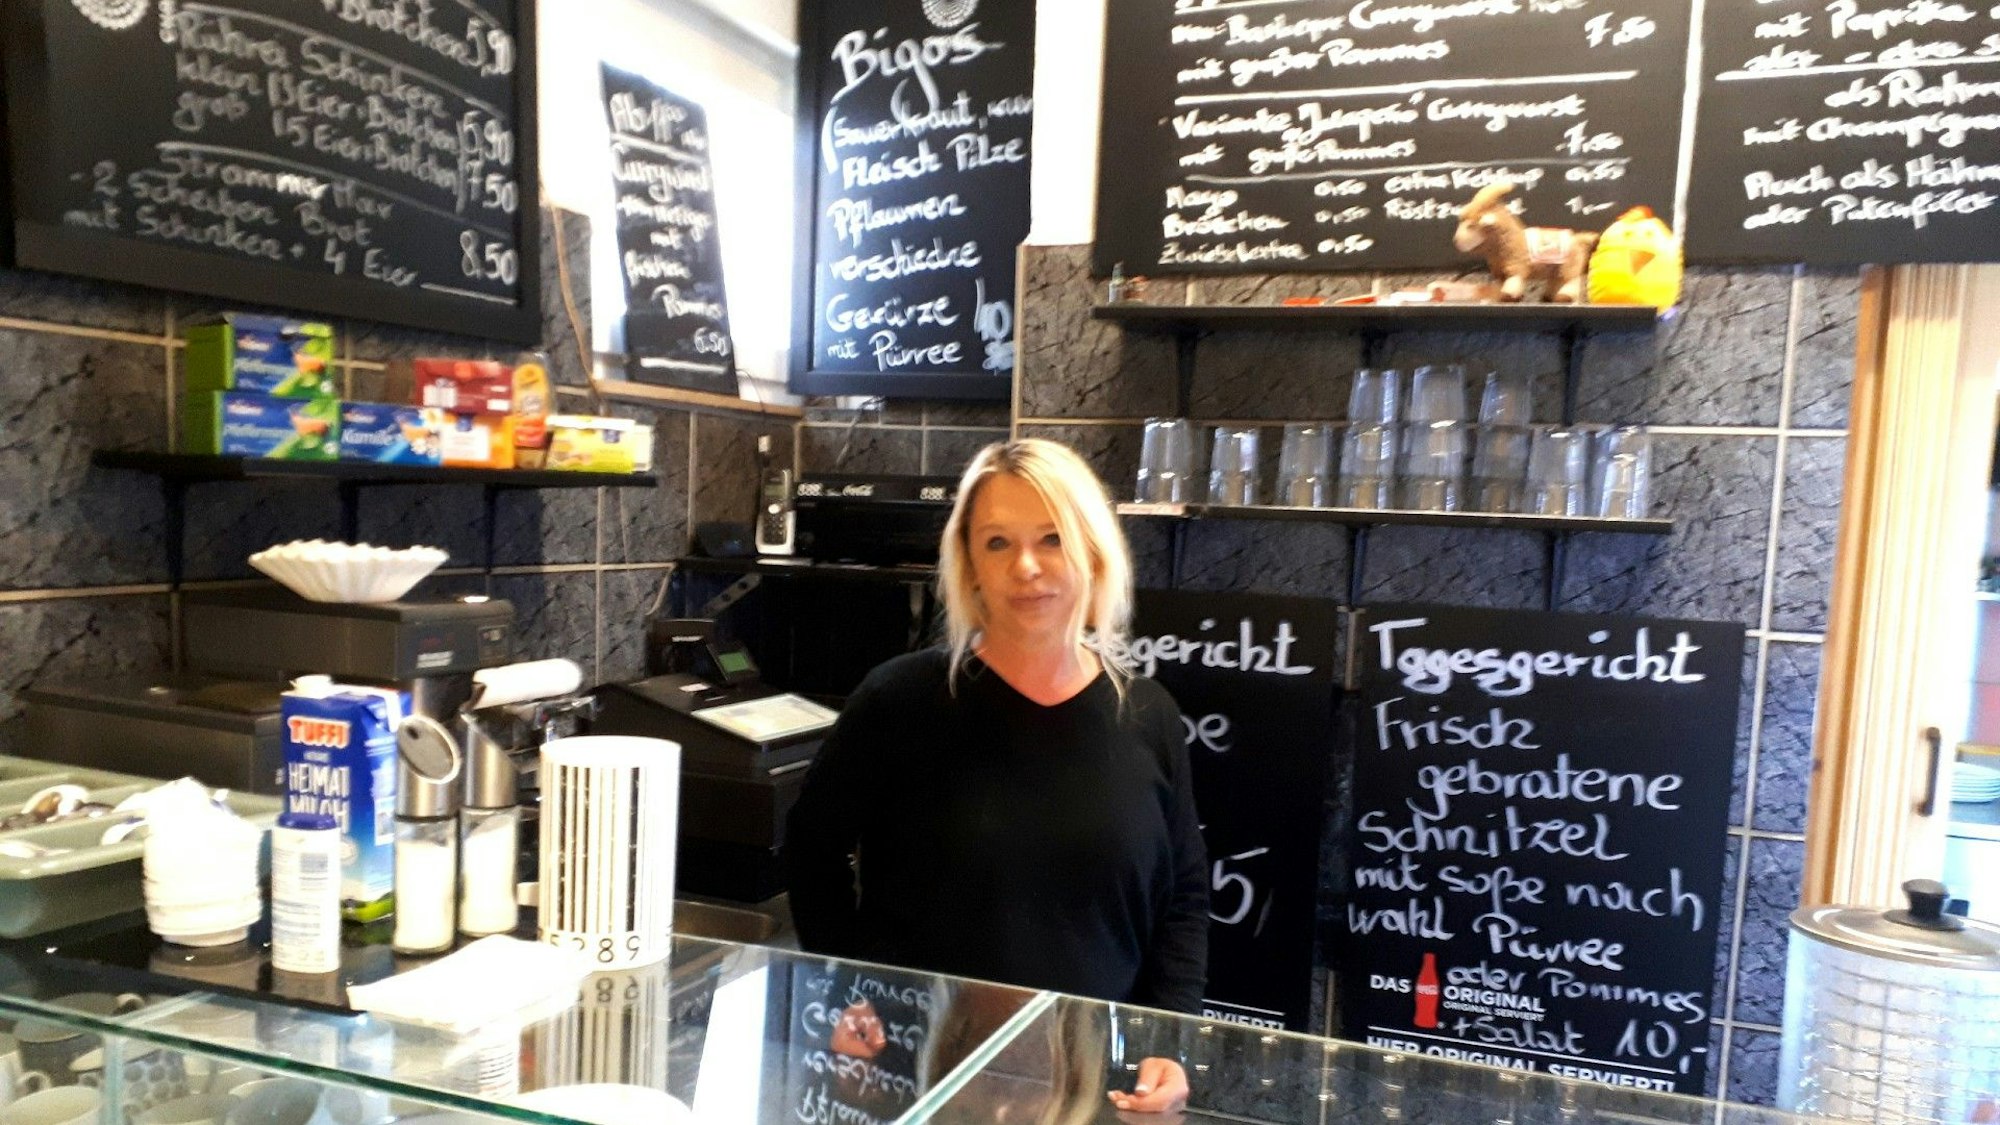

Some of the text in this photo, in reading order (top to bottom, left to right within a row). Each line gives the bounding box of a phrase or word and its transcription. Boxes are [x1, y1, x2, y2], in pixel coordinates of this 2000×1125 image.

[830, 22, 1005, 125] Bigos
[842, 140, 943, 191] Fleisch
[1743, 164, 1836, 200] Auch
[1840, 158, 1901, 190] als
[827, 192, 968, 248] Pflaumen
[1372, 697, 1541, 751] Frisch
[288, 762, 350, 798] HEIMAT
[1406, 753, 1684, 821] gebratene
[1358, 806, 1630, 863] Schnitzel
[1355, 853, 1428, 891] mit
[1565, 867, 1705, 932] nach
[1472, 912, 1625, 971] Pürree
[1370, 974, 1412, 995] DAS
[1443, 985, 1547, 1013] ORIGINAL
[1446, 960, 1705, 1024] oder Pommes
